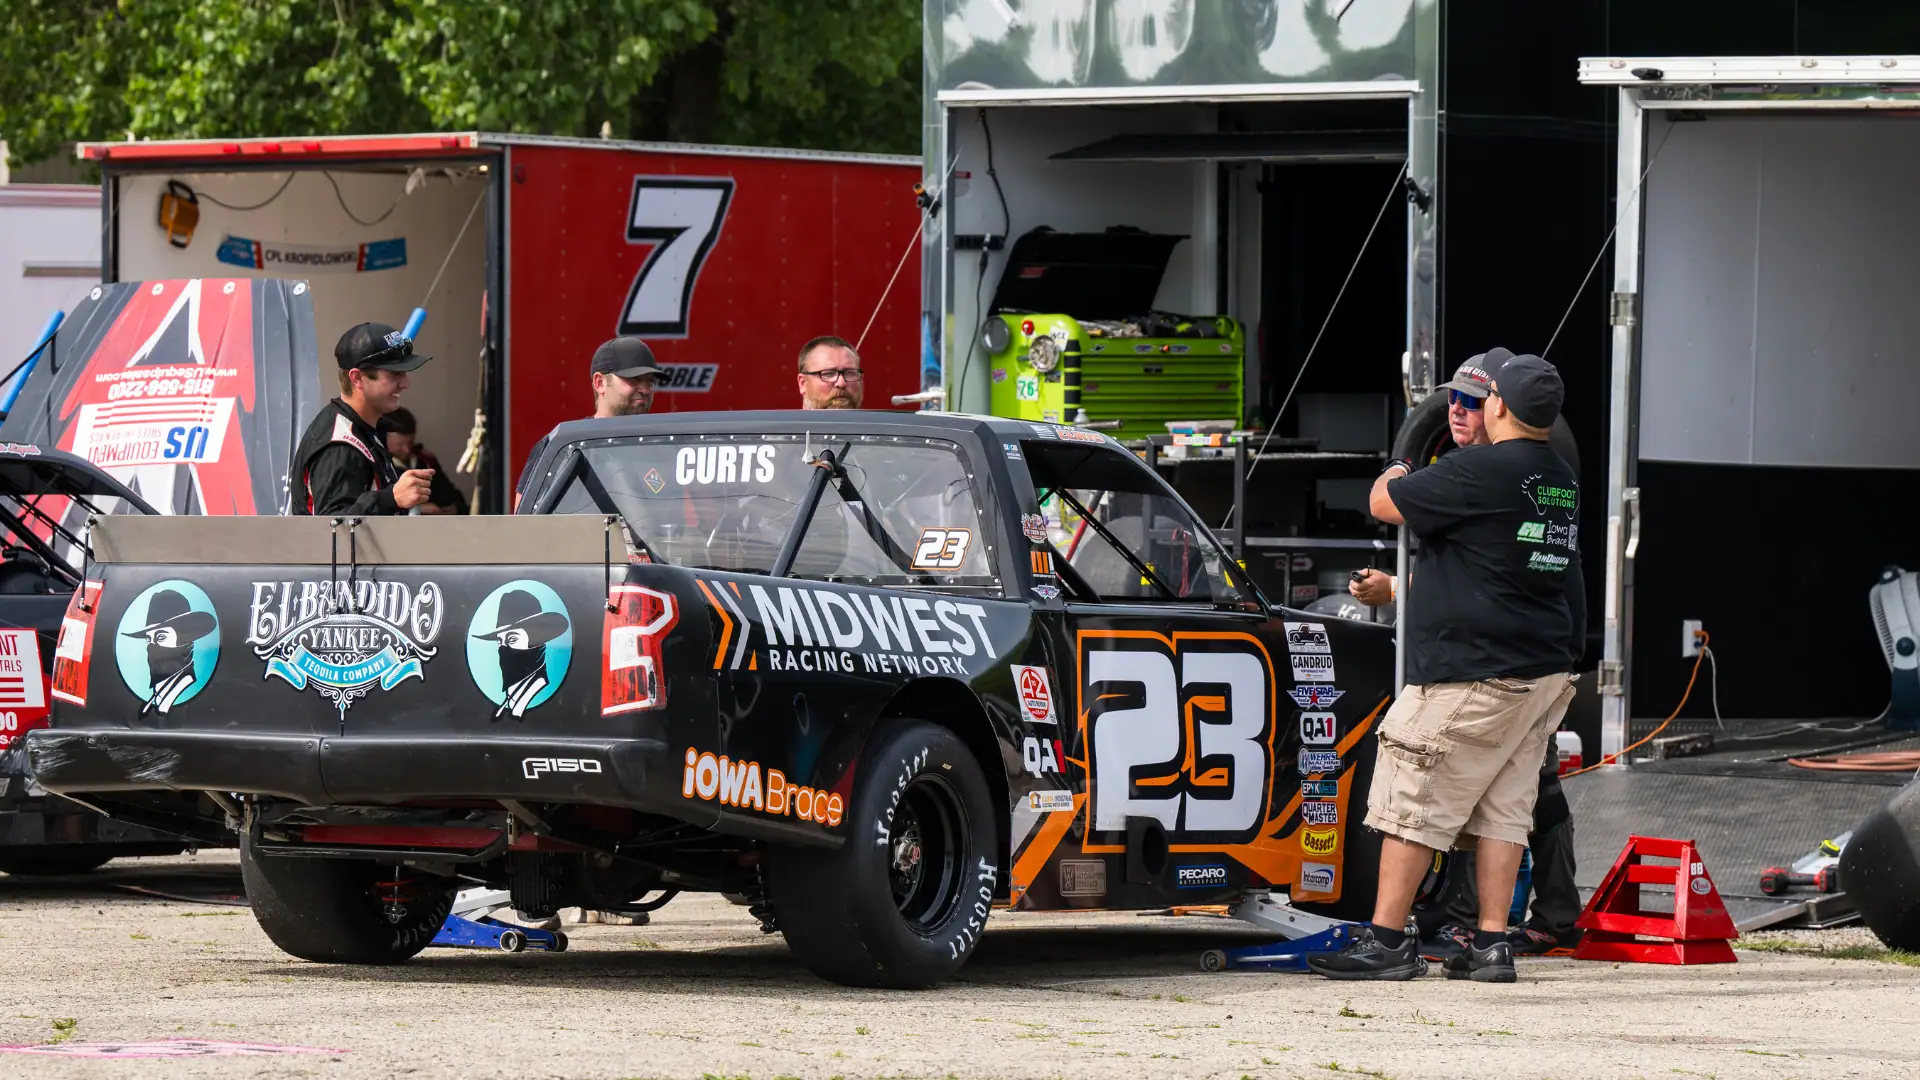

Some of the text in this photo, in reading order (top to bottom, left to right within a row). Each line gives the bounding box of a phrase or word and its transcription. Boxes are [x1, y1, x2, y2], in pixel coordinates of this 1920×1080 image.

[265, 248, 283, 263] CPL
[616, 174, 737, 339] 7
[1018, 380, 1035, 397] 76
[87, 426, 209, 465] US EQUIPMENT
[676, 444, 776, 485] CURTS
[1537, 485, 1576, 500] CLUBFOOT
[1537, 496, 1575, 509] SOLUTIONS
[1546, 520, 1568, 535] Iowa
[910, 526, 973, 571] 23
[1546, 534, 1568, 547] Brace
[749, 585, 997, 660] MIDWEST
[308, 626, 381, 654] YANKEE
[303, 656, 386, 681] TEQUILA COMPANY
[769, 649, 970, 676] RACING NETWORK
[1292, 656, 1332, 669] GANDRUD
[1297, 686, 1333, 697] FIVE STAR
[1303, 718, 1333, 740] QA1
[1083, 640, 1270, 842] 23
[522, 757, 602, 779] F150
[1023, 737, 1067, 779] QA1
[1302, 802, 1336, 817] QUARTER
[1308, 812, 1338, 824] MASTER
[1304, 832, 1335, 851] Bassett
[1178, 868, 1226, 880] PECARO
